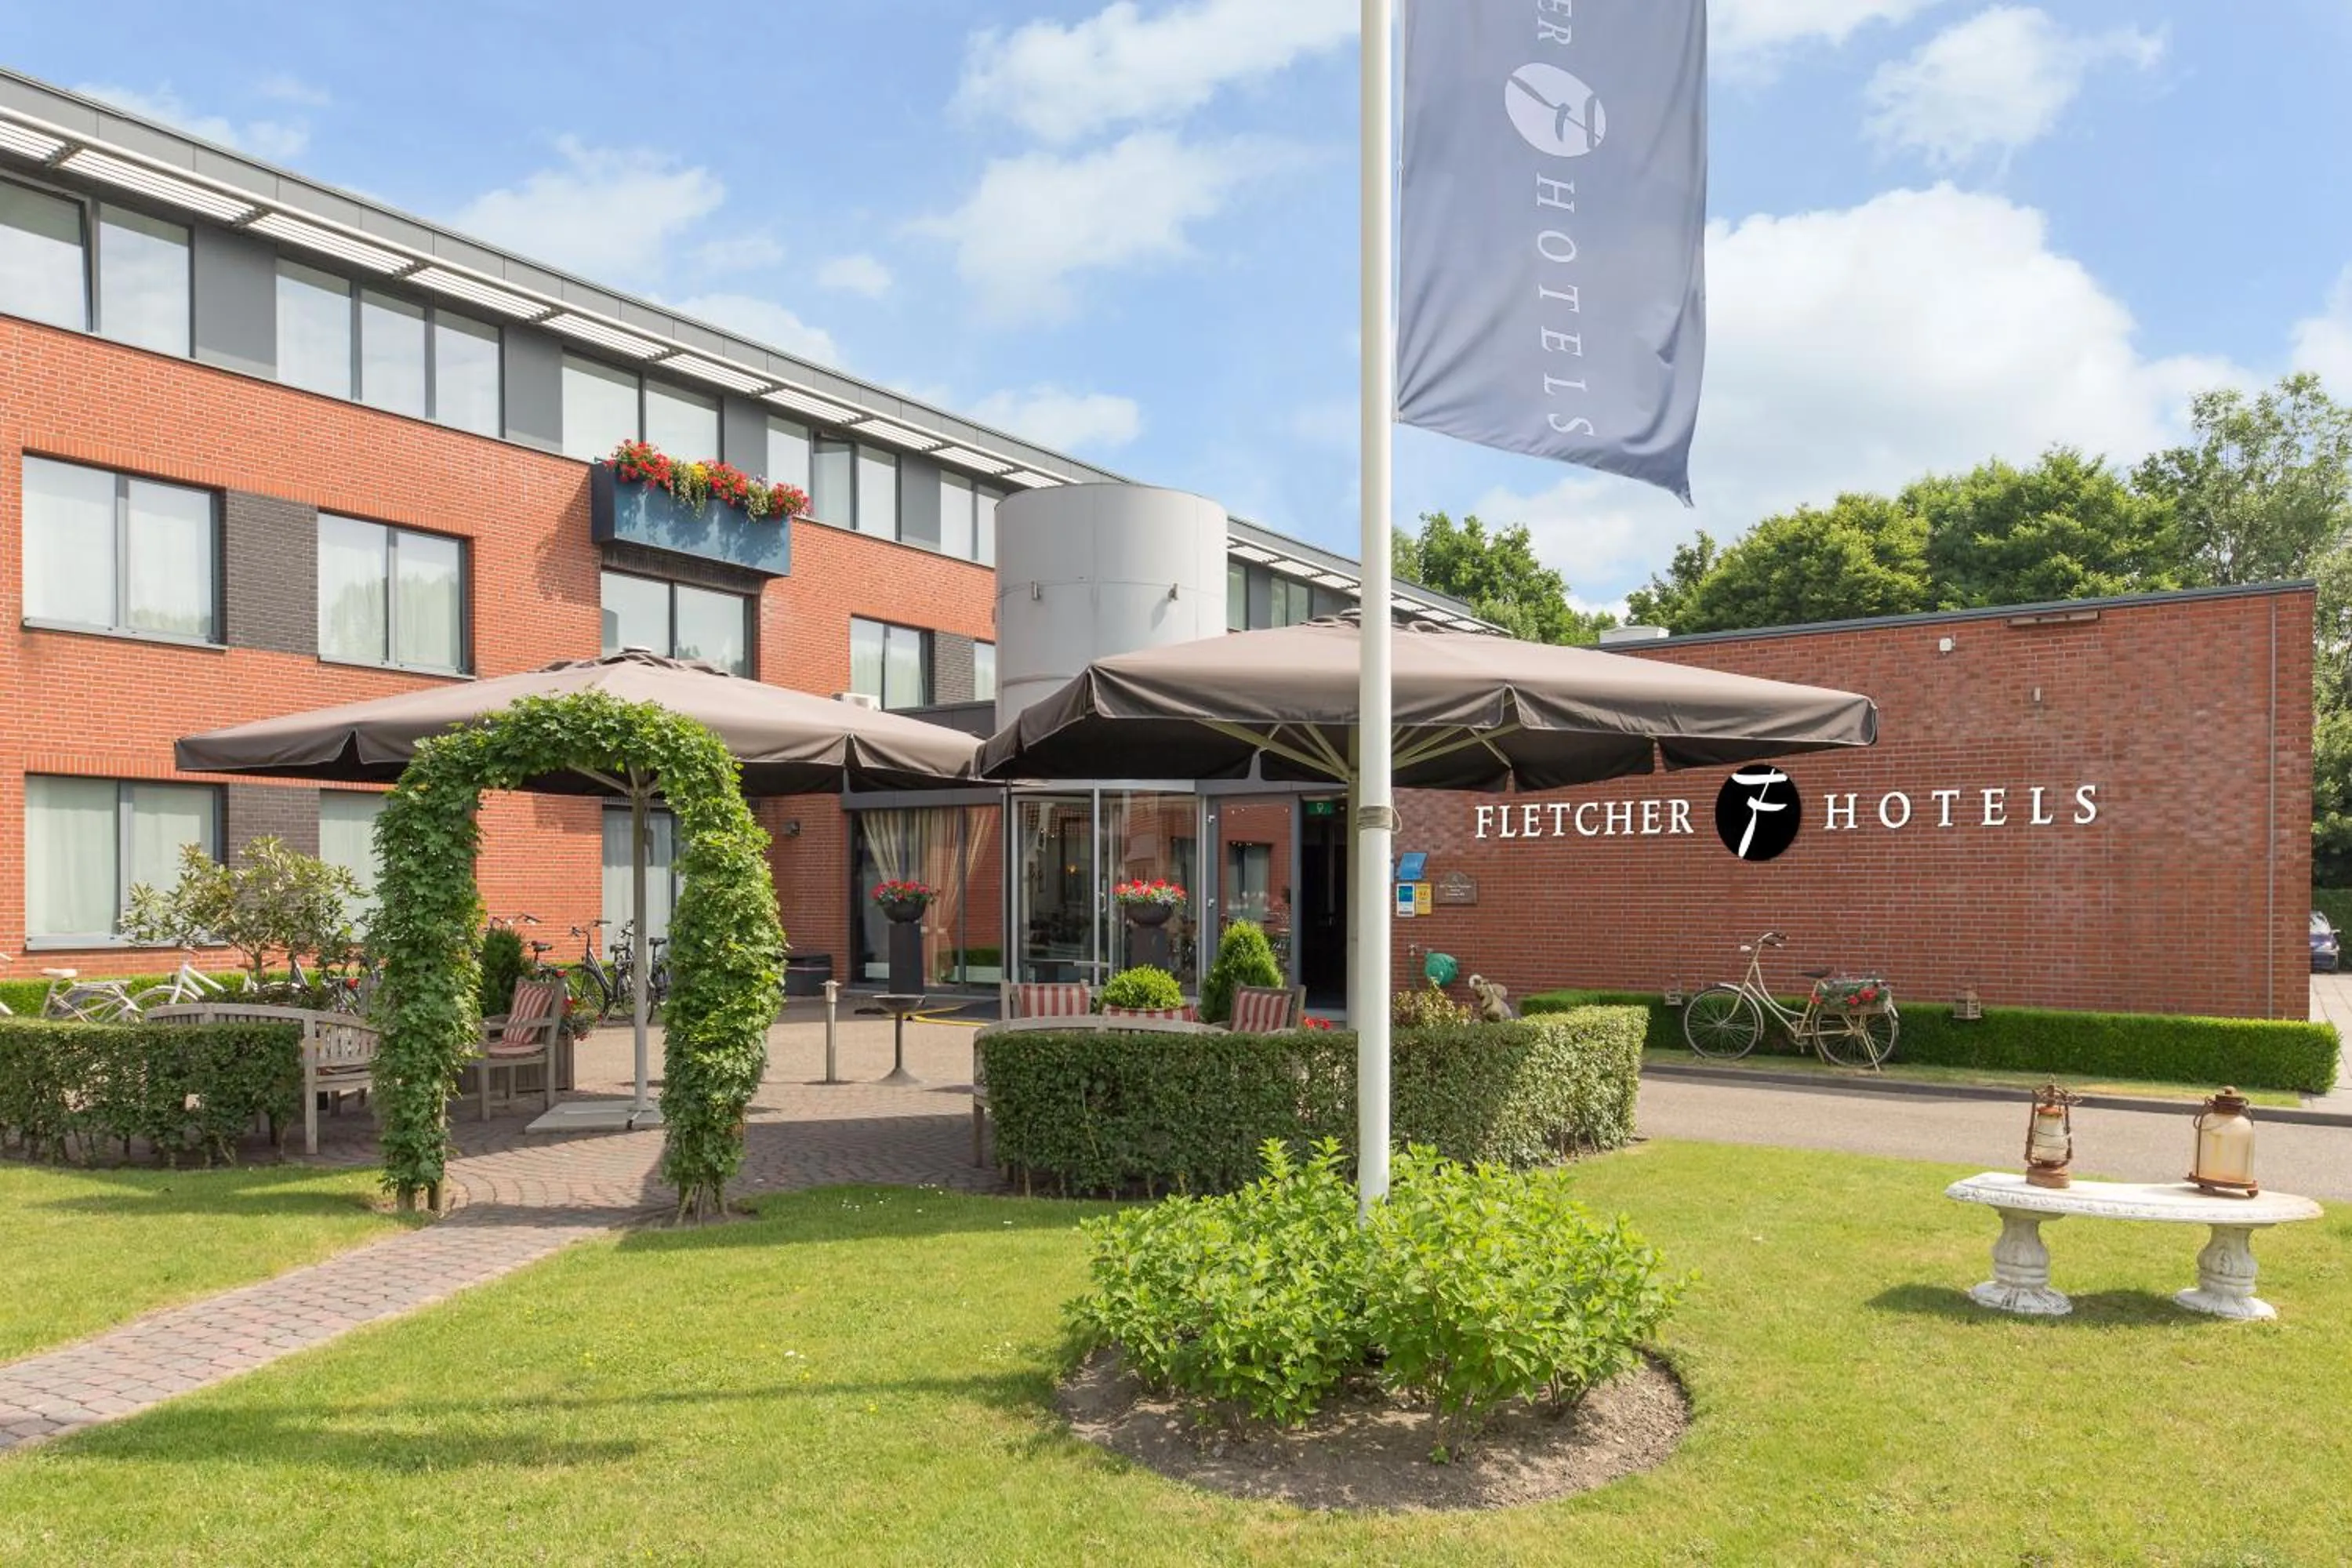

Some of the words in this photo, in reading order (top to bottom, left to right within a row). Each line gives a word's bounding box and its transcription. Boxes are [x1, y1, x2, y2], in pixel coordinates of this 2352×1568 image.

[1537, 172, 1595, 437] HOTELS
[1475, 798, 1694, 839] FLETCHER
[1824, 785, 2099, 830] HOTELS
